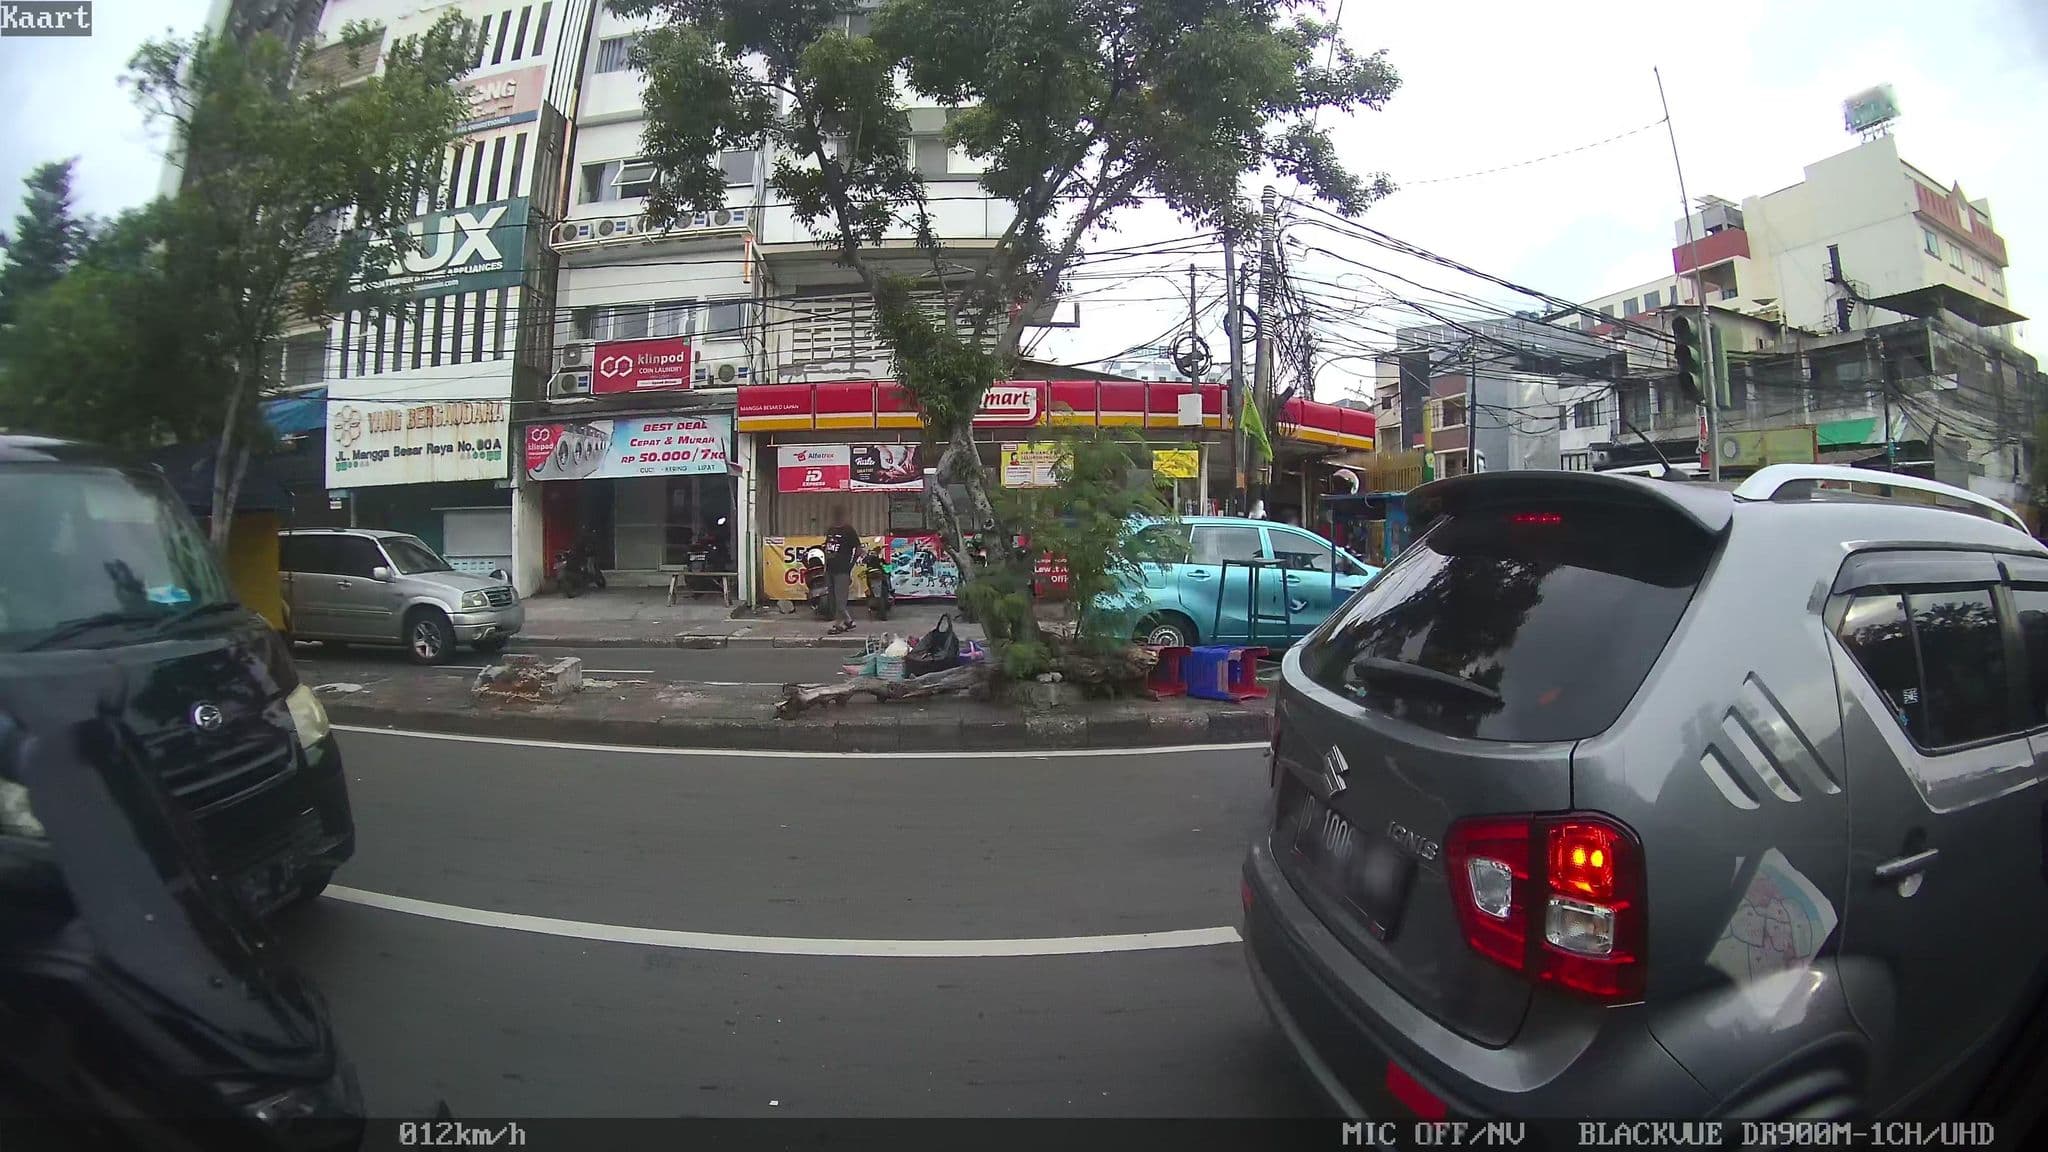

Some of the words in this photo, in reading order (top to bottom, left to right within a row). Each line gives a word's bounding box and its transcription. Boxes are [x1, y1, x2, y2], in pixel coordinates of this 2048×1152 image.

[447, 261, 504, 275] APPLIANCES
[637, 351, 685, 366] klinpod
[638, 367, 654, 375] COIN
[643, 422, 674, 432] BEST
[676, 421, 708, 431] DEAL
[664, 436, 673, 445] &
[352, 449, 390, 462] Mangga
[393, 445, 423, 457] Besar
[426, 442, 454, 456] Raya
[1388, 820, 1439, 861] IGNIS
